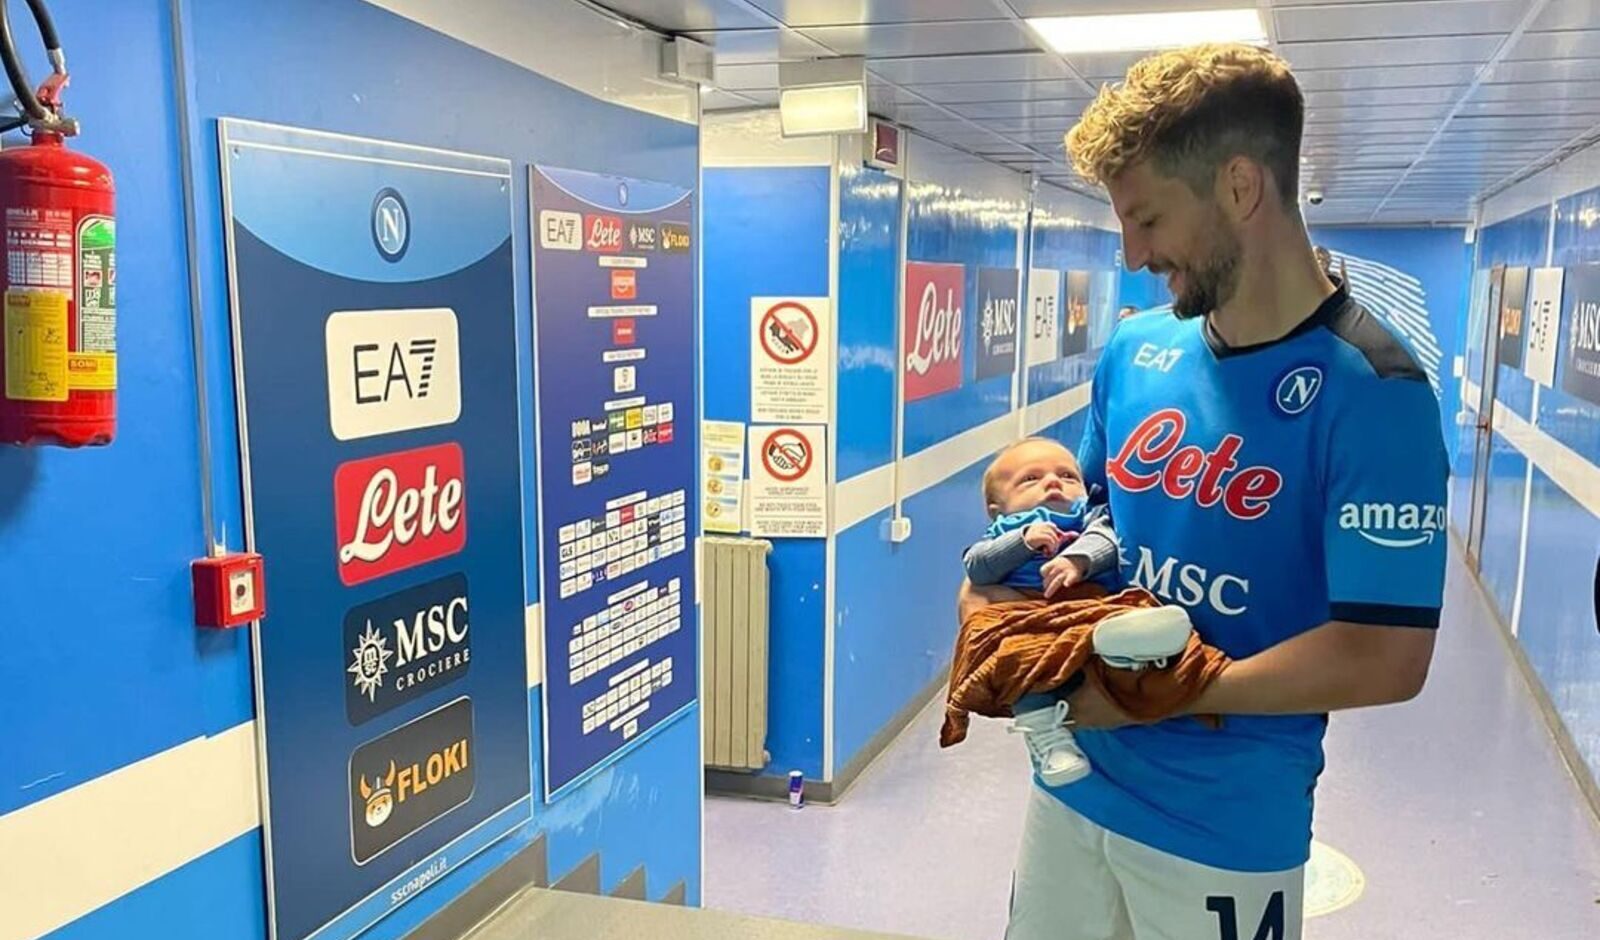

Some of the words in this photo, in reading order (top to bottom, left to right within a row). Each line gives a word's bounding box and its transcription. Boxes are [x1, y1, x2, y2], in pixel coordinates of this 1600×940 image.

[382, 207, 401, 243] N
[547, 218, 575, 244] EA7
[587, 218, 621, 248] Lete
[906, 281, 962, 375] Lete
[353, 338, 437, 405] EA7
[1133, 343, 1185, 373] EA7
[1282, 375, 1319, 406] N
[1106, 407, 1284, 521] Lete
[339, 464, 463, 564] Lete
[1128, 545, 1250, 616] MSC
[393, 596, 469, 667] MSC
[395, 648, 471, 692] CROCIERE
[397, 738, 469, 804] FLOKI
[391, 856, 448, 905] sscnapoli.it
[1206, 890, 1286, 940] 14
